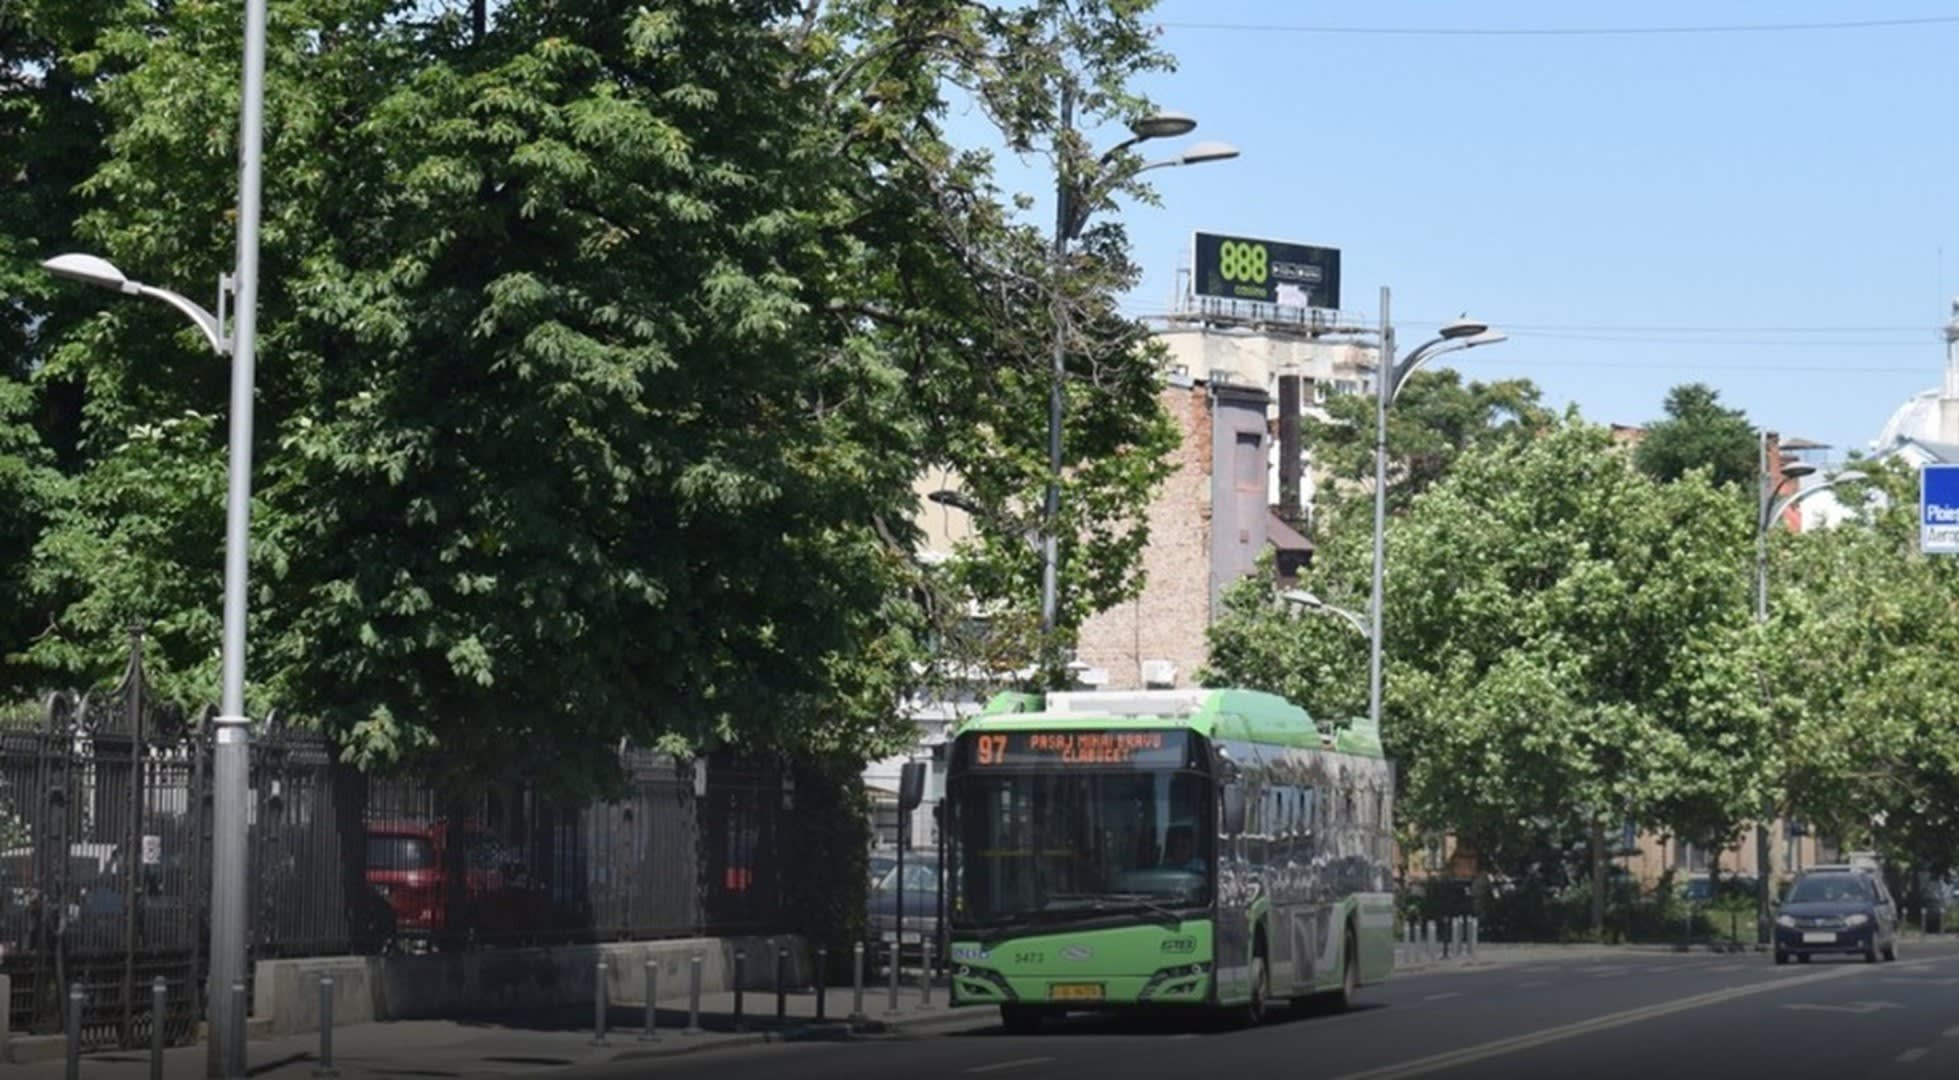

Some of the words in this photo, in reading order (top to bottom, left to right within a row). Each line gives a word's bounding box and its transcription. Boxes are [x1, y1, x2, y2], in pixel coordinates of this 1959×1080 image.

[1220, 240, 1267, 284] 888
[978, 735, 1007, 764] 97
[1030, 734, 1073, 750] PASAJ
